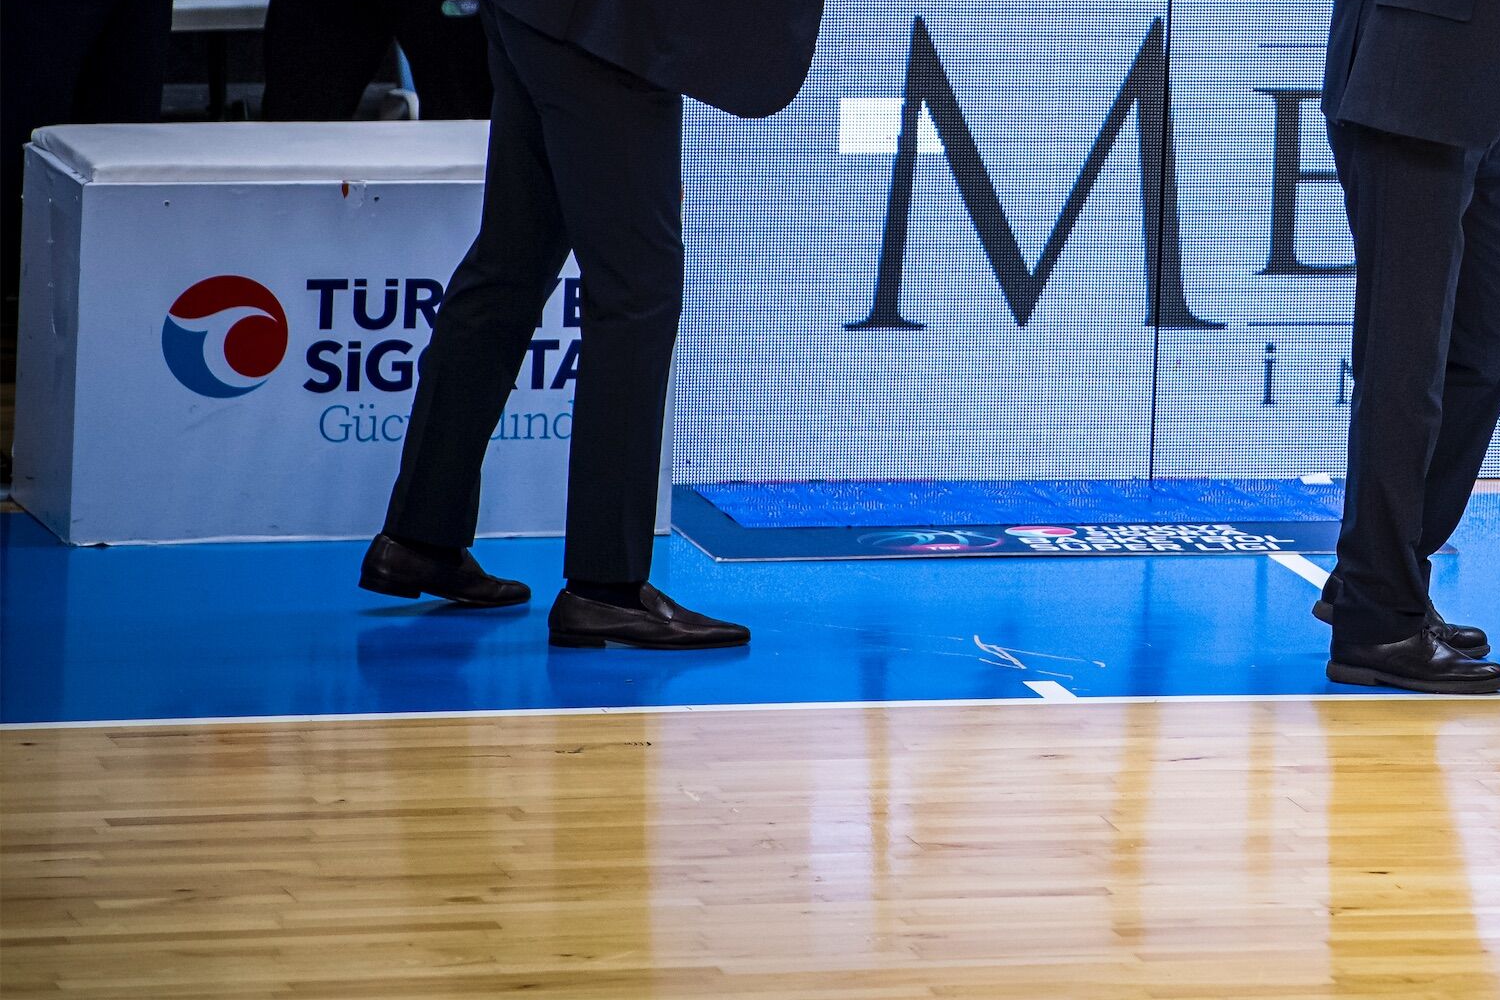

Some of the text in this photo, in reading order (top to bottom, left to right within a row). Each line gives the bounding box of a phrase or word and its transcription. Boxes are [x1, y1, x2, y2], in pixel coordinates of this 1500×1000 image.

[303, 339, 582, 393] SİGTA
[319, 403, 411, 443] Güc
[1018, 535, 1295, 544] BASKETBOL
